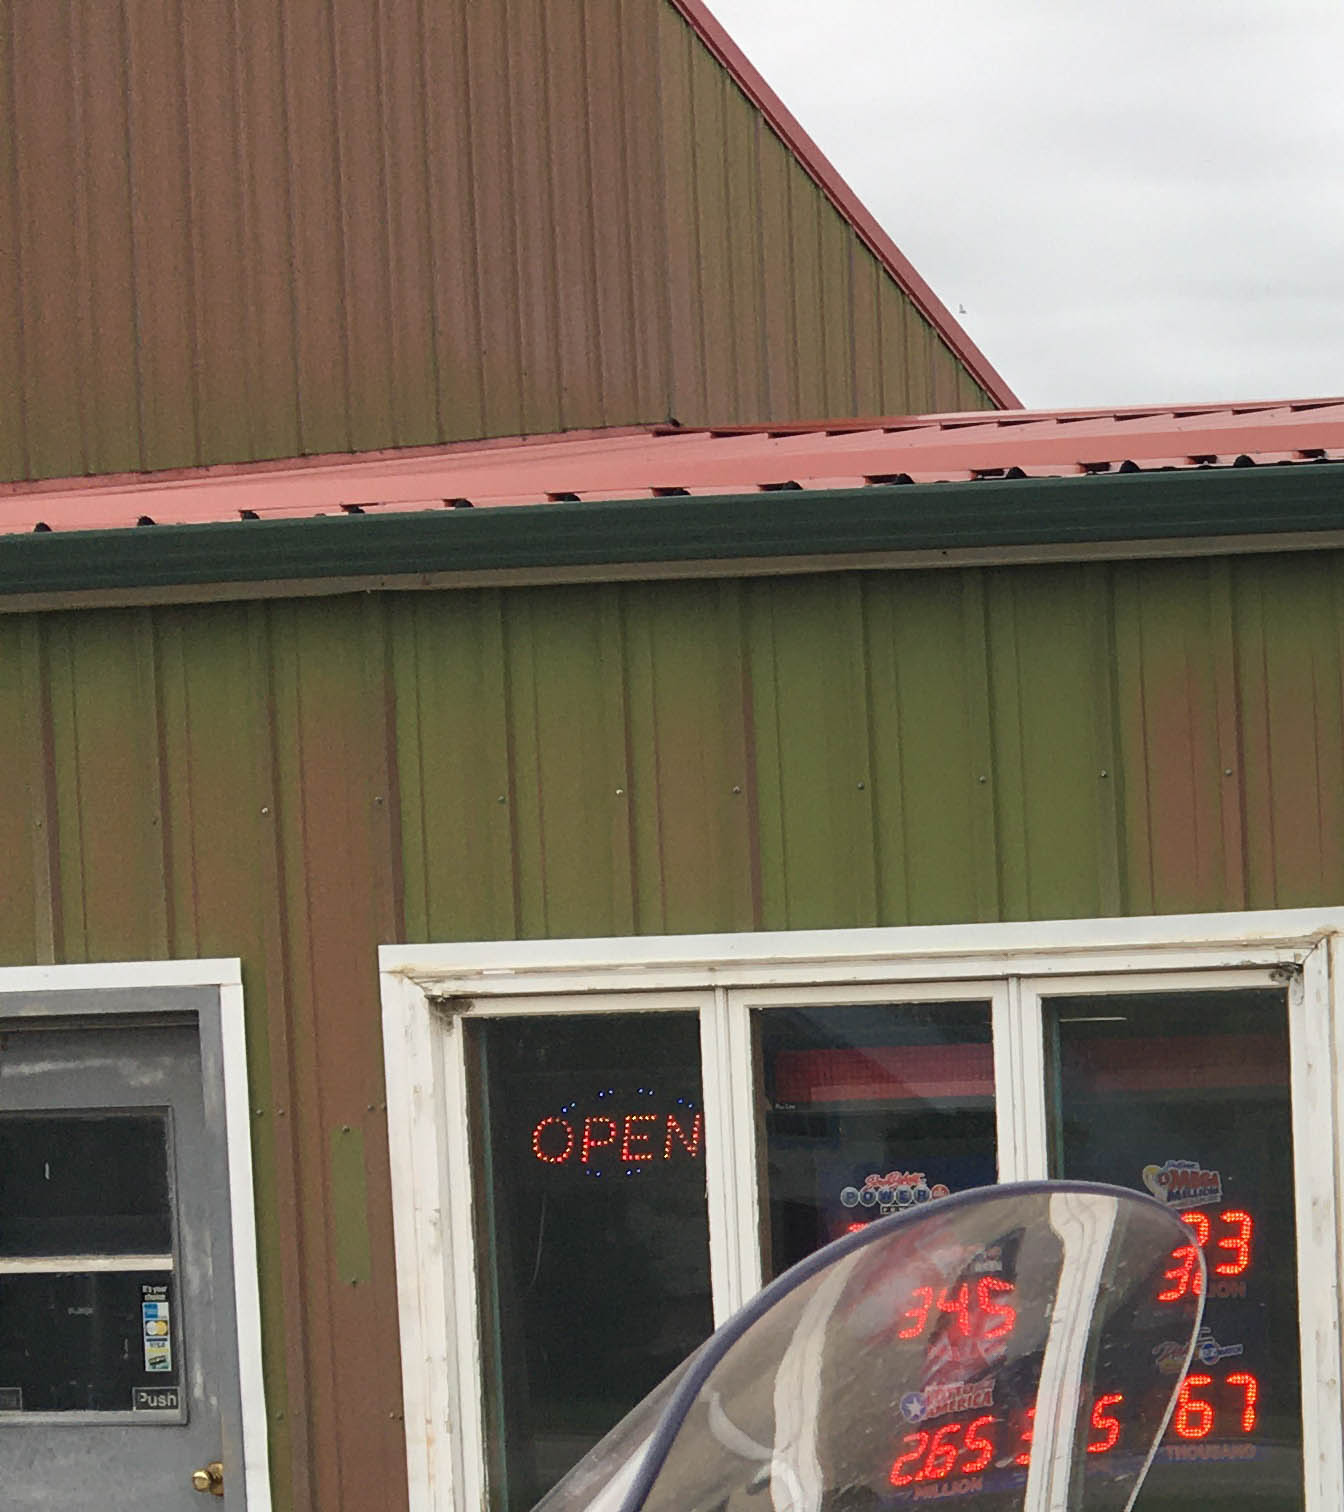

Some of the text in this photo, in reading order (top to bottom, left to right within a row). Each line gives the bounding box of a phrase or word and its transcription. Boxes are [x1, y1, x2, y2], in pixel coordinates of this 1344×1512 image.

[530, 1112, 702, 1166] OPEN
[899, 1275, 1017, 1339] 345
[1175, 1374, 1257, 1438] 67
[889, 1414, 993, 1486] 265
